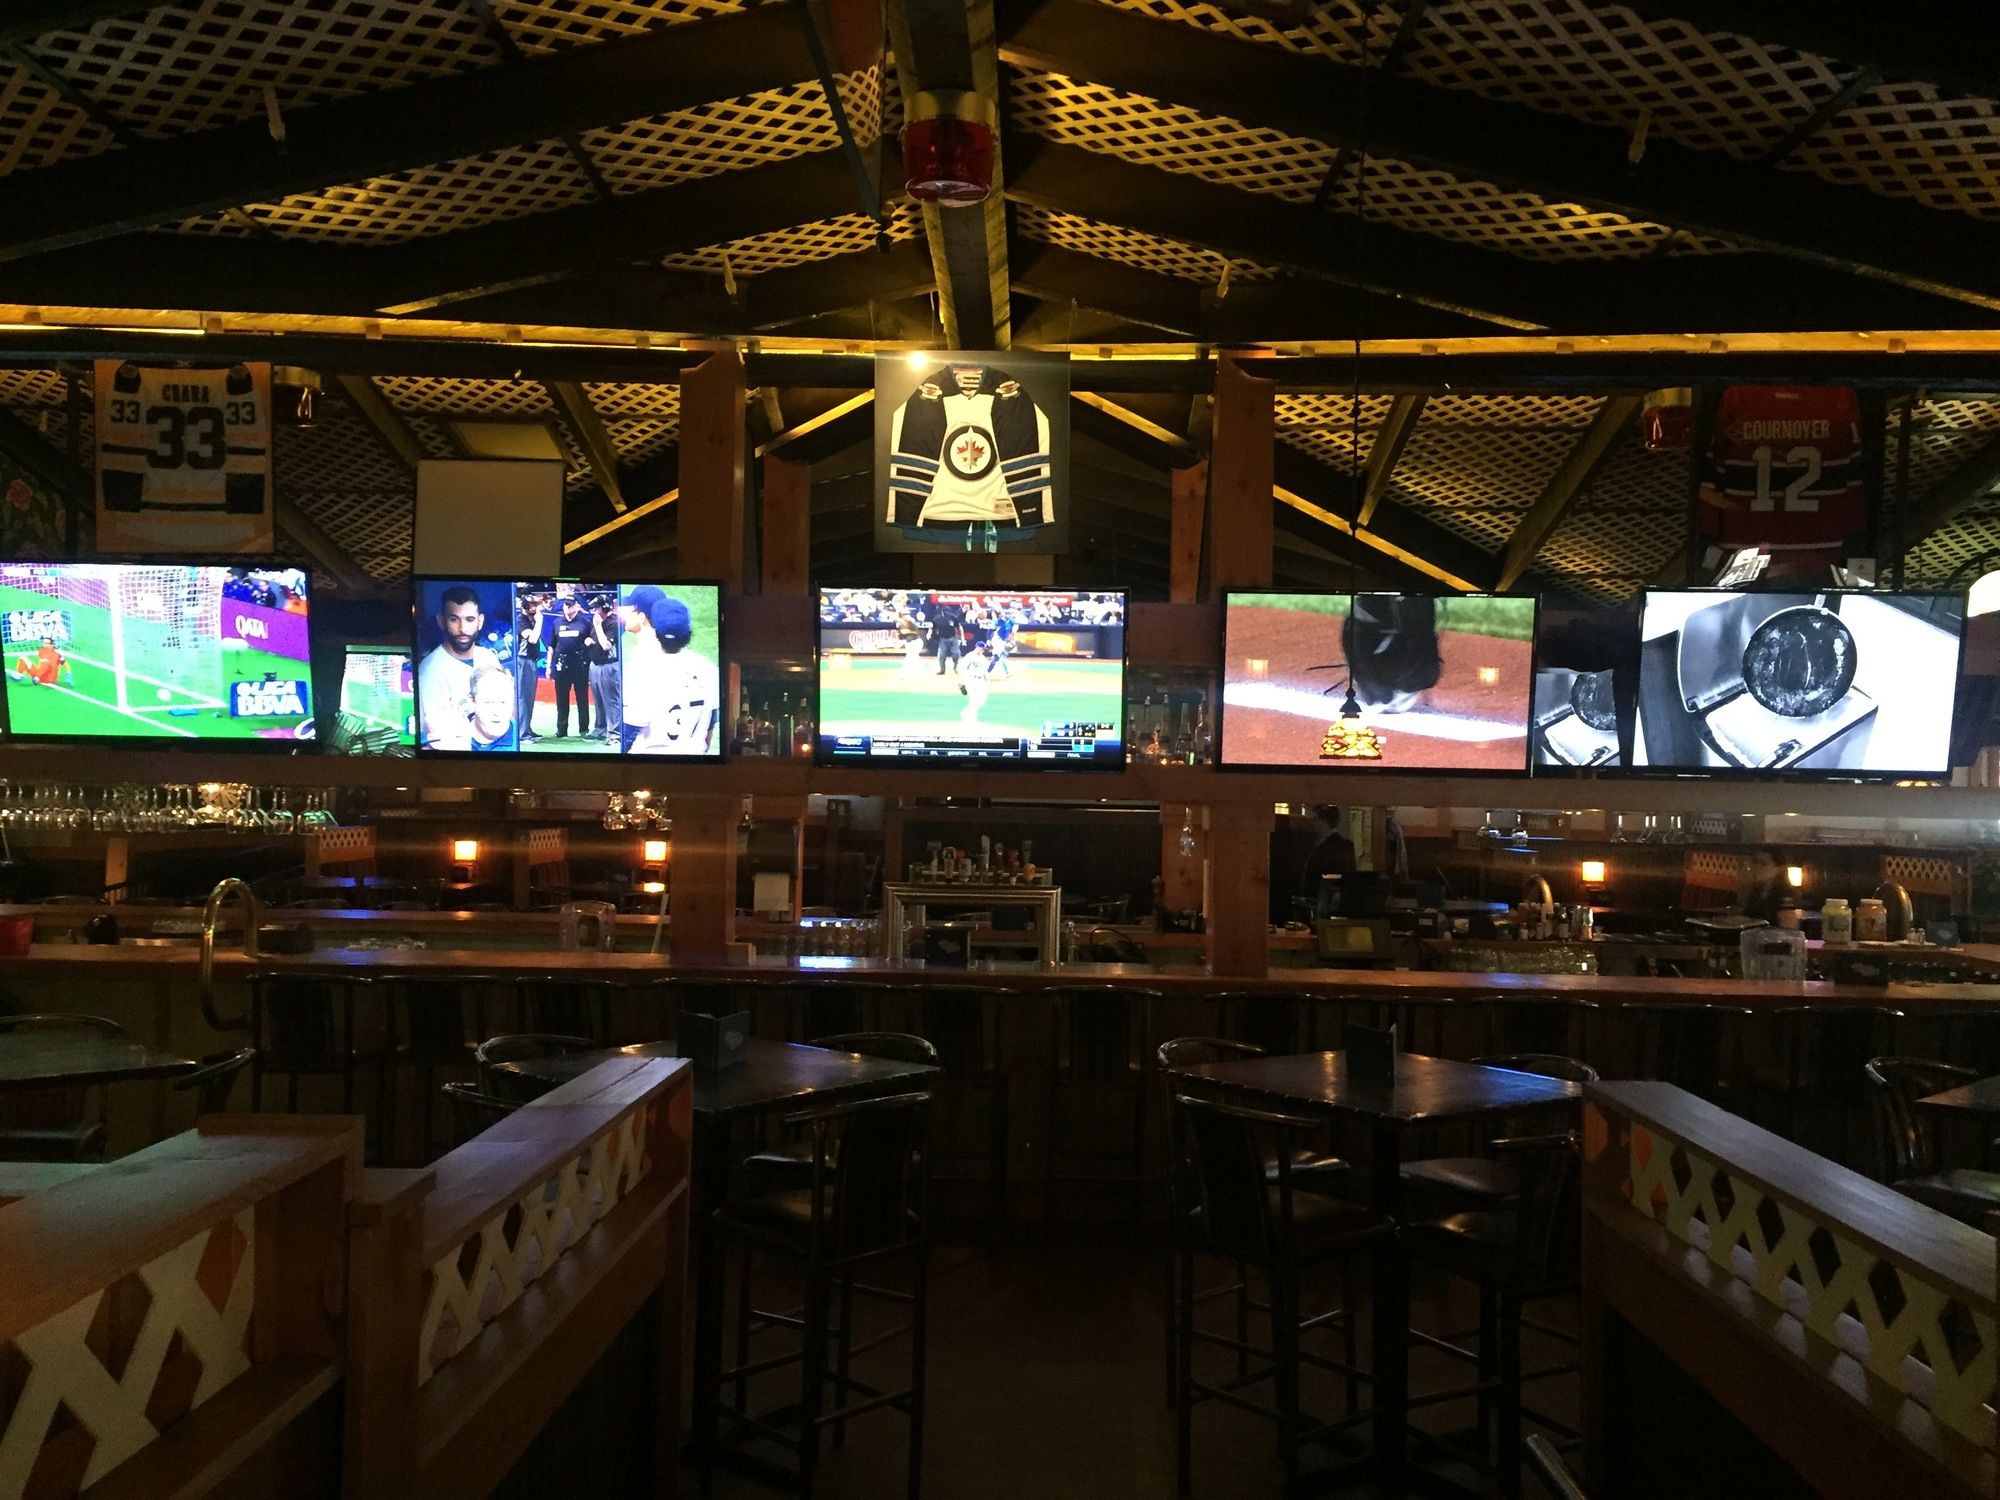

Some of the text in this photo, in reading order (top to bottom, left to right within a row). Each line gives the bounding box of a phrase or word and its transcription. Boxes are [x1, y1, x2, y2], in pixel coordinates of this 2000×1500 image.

[111, 399, 141, 424] 33
[225, 401, 256, 425] 33
[146, 406, 226, 469] 33
[1743, 418, 1831, 440] COURNOYER
[1749, 445, 1822, 513] 12
